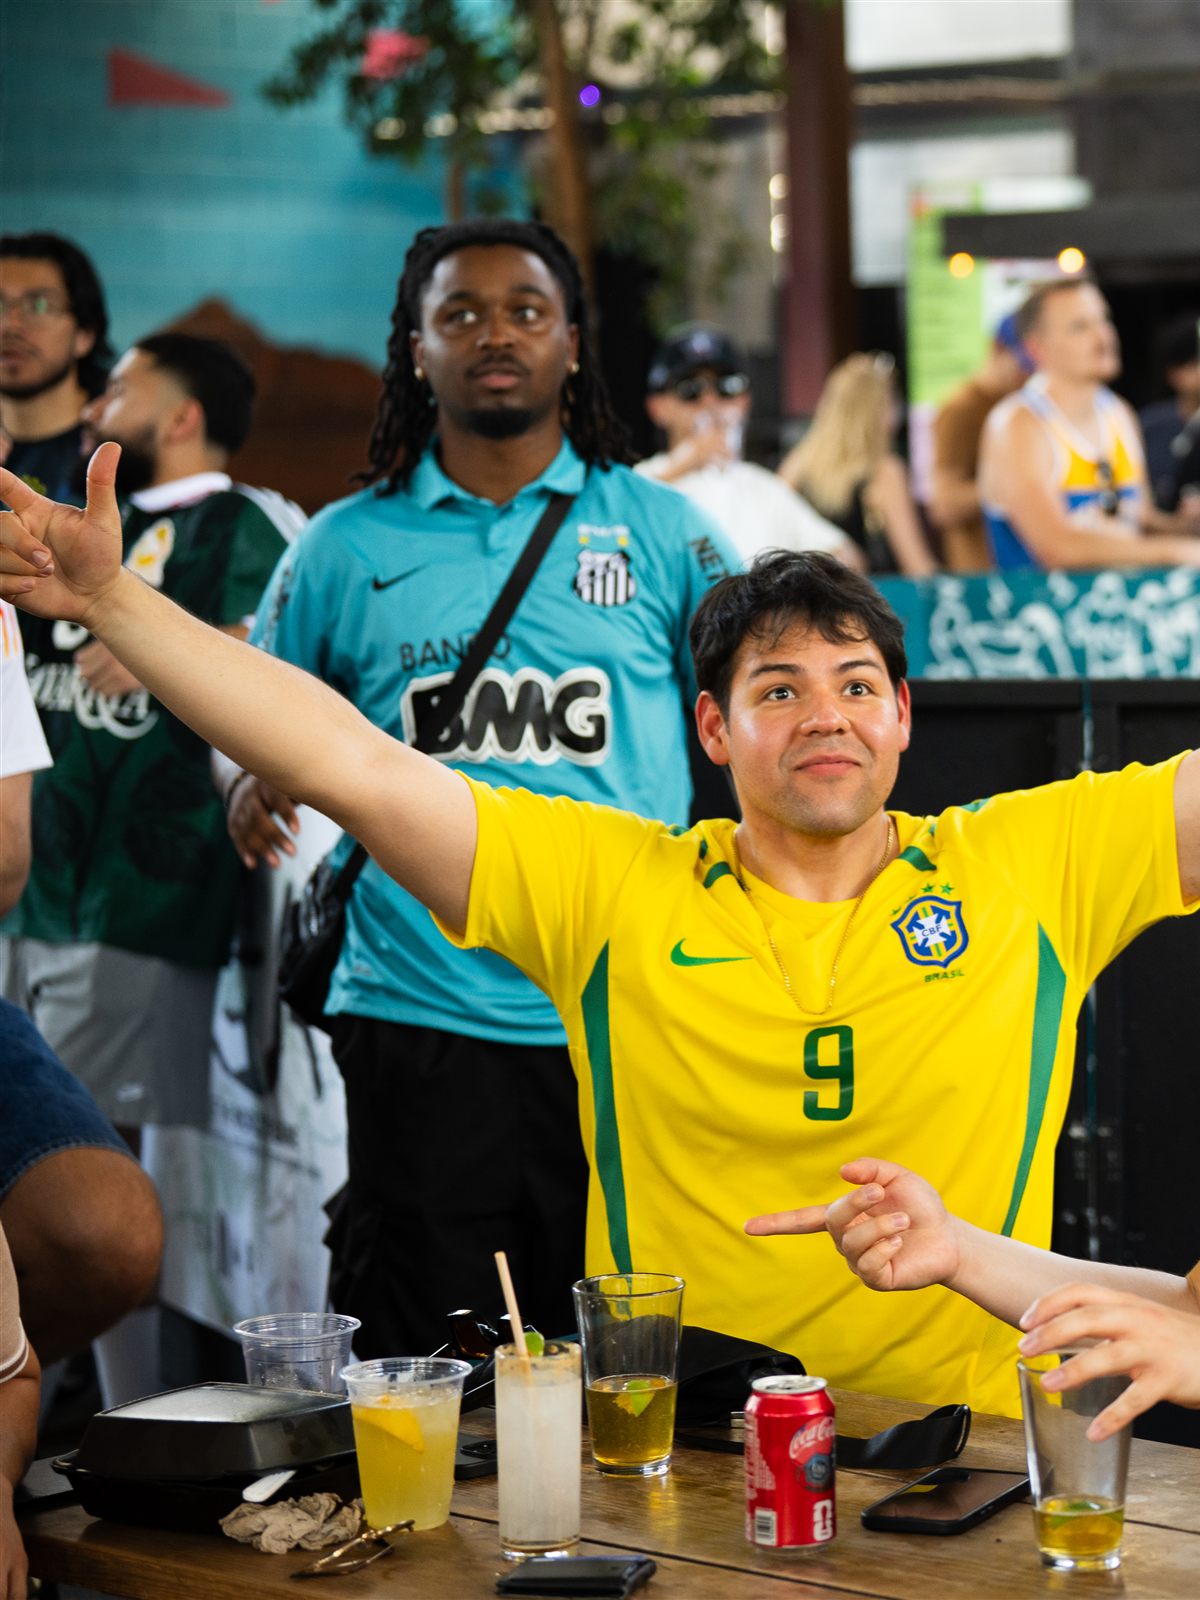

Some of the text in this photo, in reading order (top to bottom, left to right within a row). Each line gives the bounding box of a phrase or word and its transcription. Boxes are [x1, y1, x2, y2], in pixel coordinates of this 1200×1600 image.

[400, 632, 511, 671] BANO
[406, 670, 610, 763] BMG
[921, 922, 942, 938] CBF
[924, 969, 964, 983] BRASIL
[803, 1025, 854, 1121] 9
